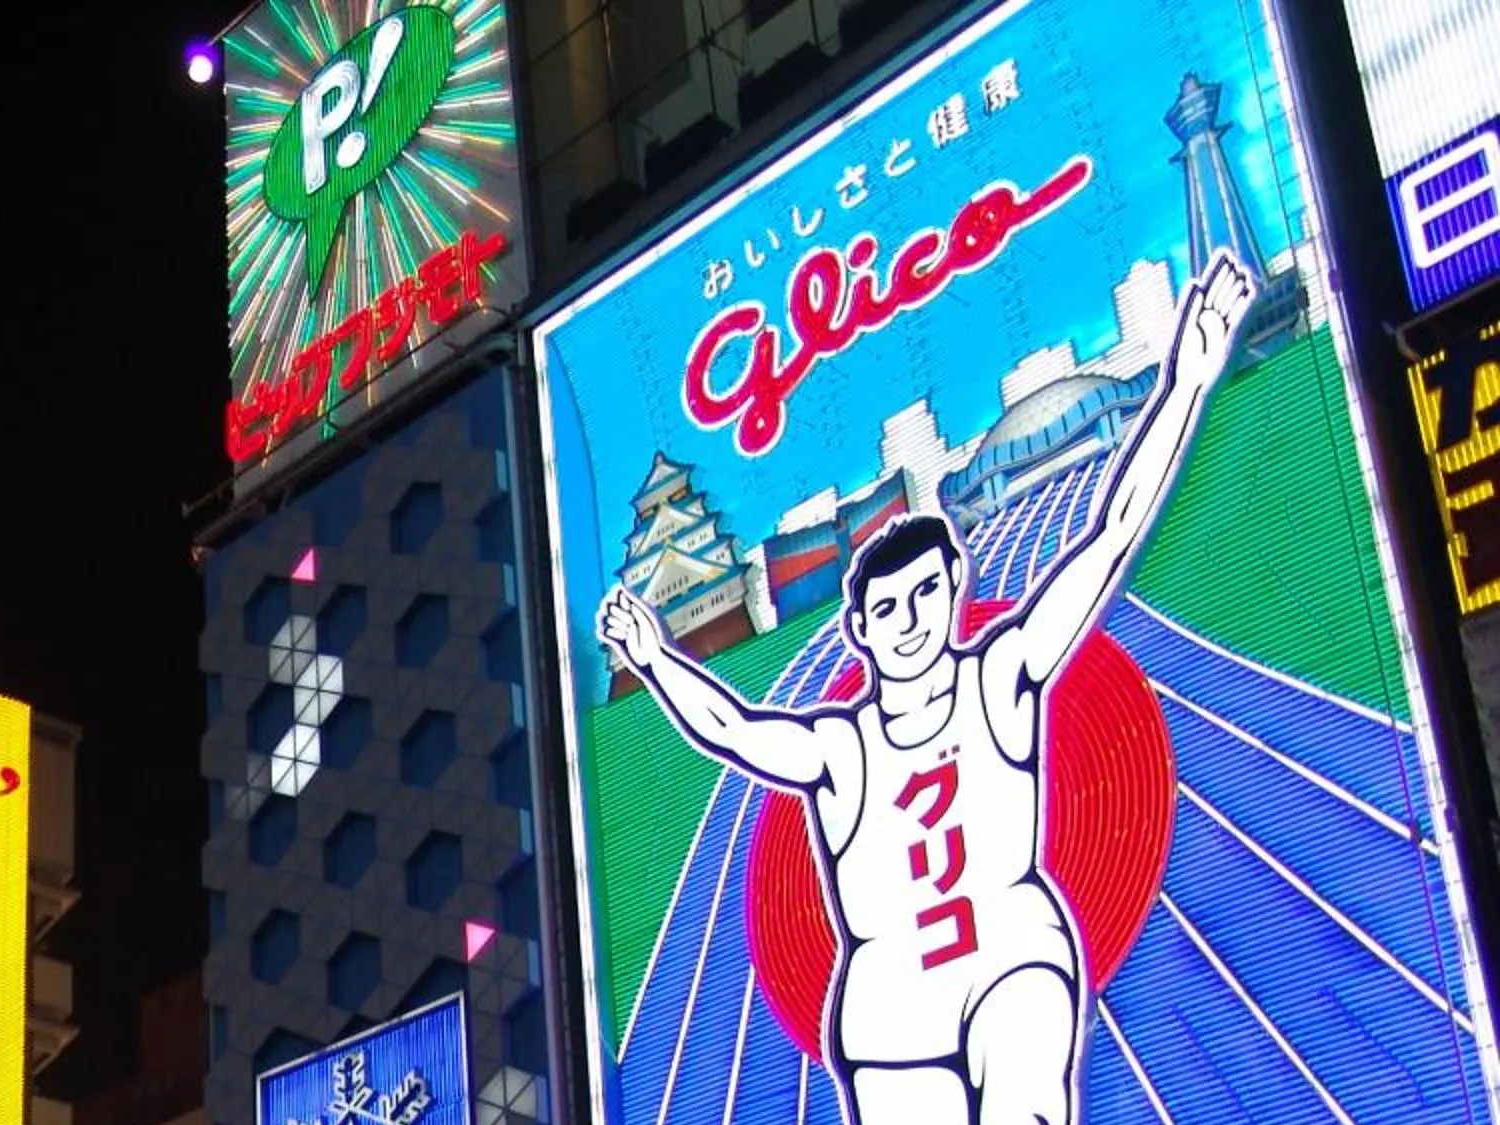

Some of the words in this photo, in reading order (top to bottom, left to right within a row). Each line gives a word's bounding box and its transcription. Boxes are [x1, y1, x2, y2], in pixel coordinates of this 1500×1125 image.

[704, 59, 1021, 298] おいしさと健康
[893, 745, 978, 970] グリコ
